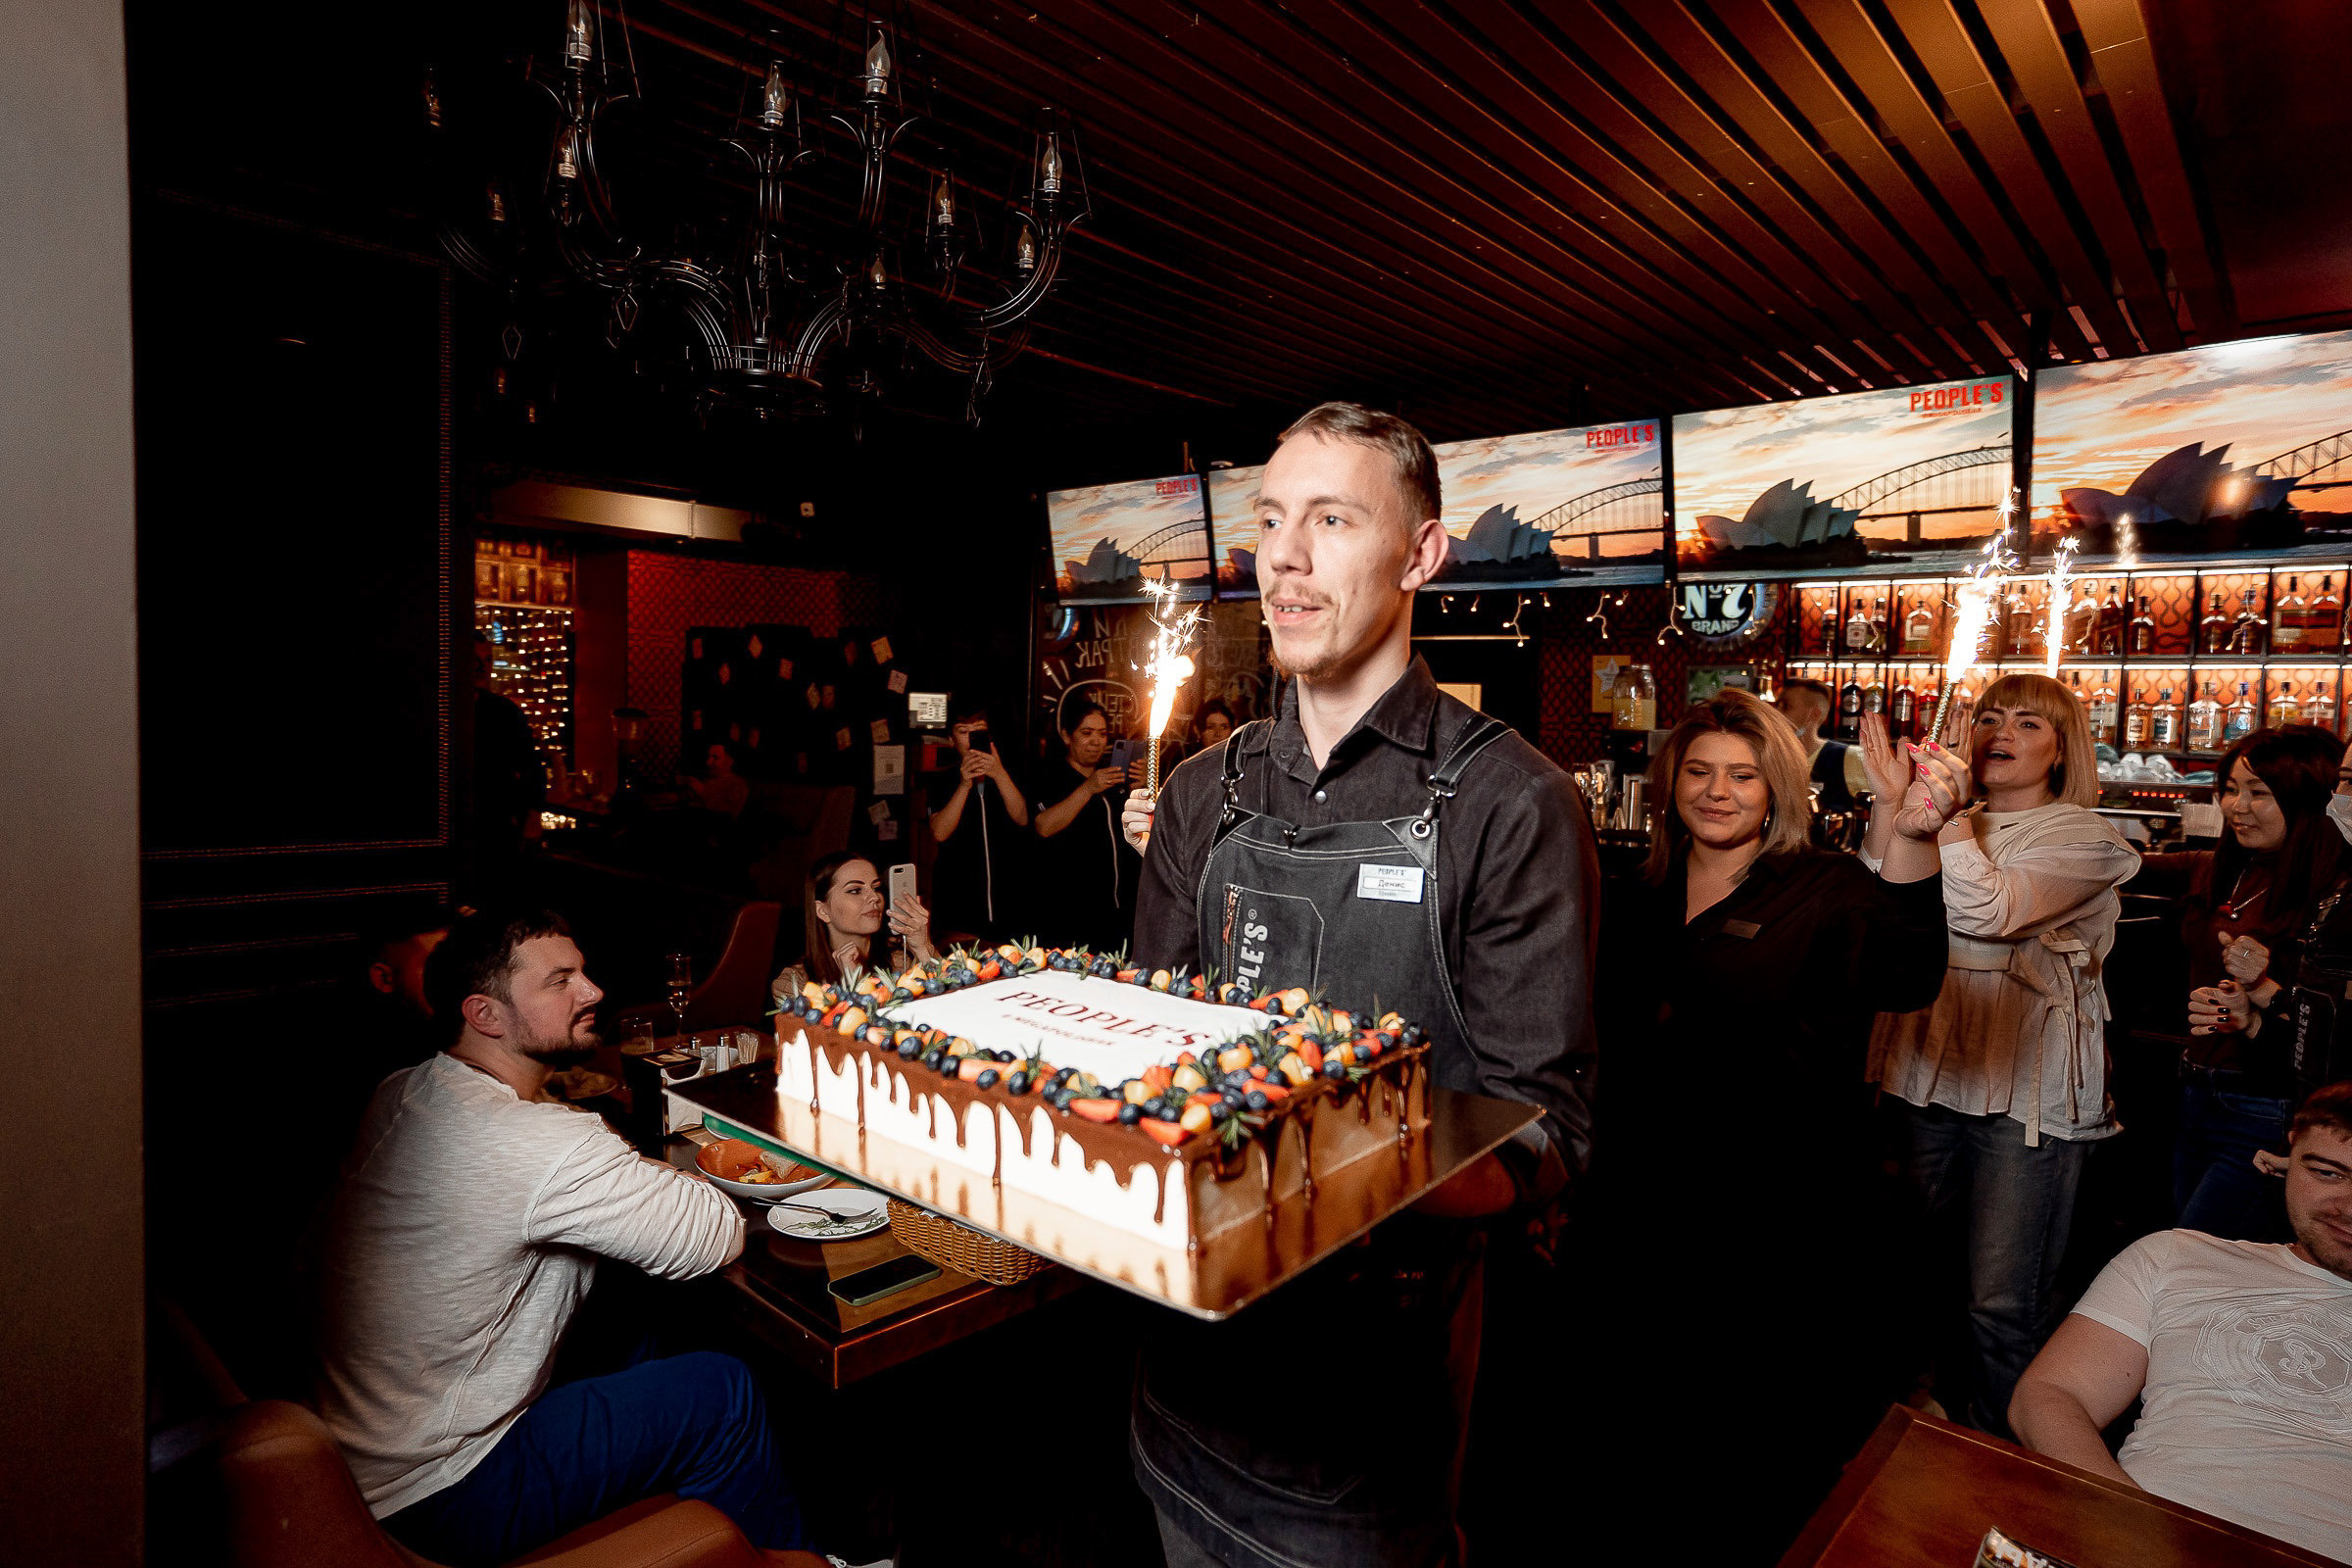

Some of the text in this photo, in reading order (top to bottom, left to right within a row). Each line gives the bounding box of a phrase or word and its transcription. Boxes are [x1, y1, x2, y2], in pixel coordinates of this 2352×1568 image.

[1910, 381, 2003, 413] PEOPLE'S
[1586, 424, 1655, 449] PEOPLE'S
[1236, 922, 1268, 994] PLE'S
[996, 991, 1211, 1047] PEOPLE'S
